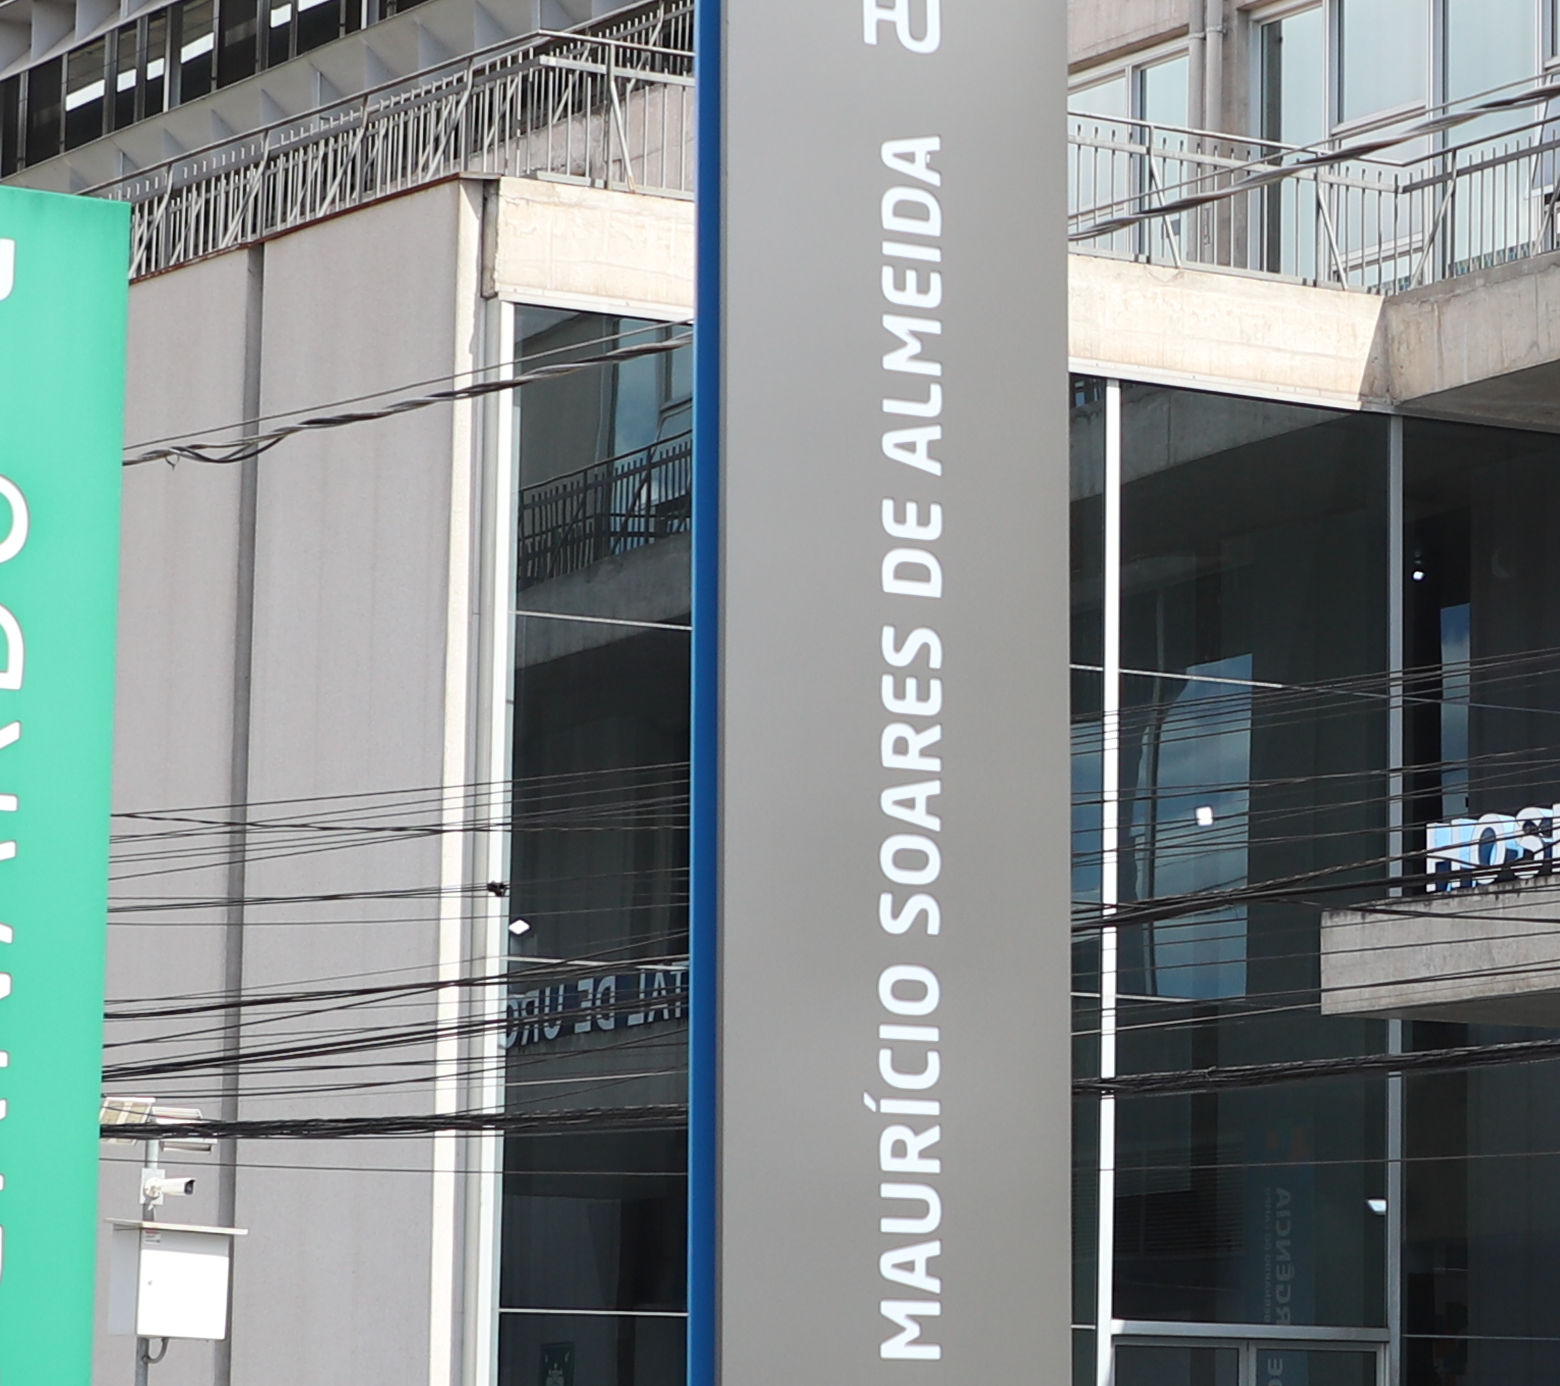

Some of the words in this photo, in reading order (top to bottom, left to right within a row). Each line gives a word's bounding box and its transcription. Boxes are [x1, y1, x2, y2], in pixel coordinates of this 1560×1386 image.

[880, 134, 943, 477] ALMEIDA
[881, 499, 943, 599] DE
[880, 624, 943, 938] SOARES
[863, 962, 942, 1361] MAURÍCIO
